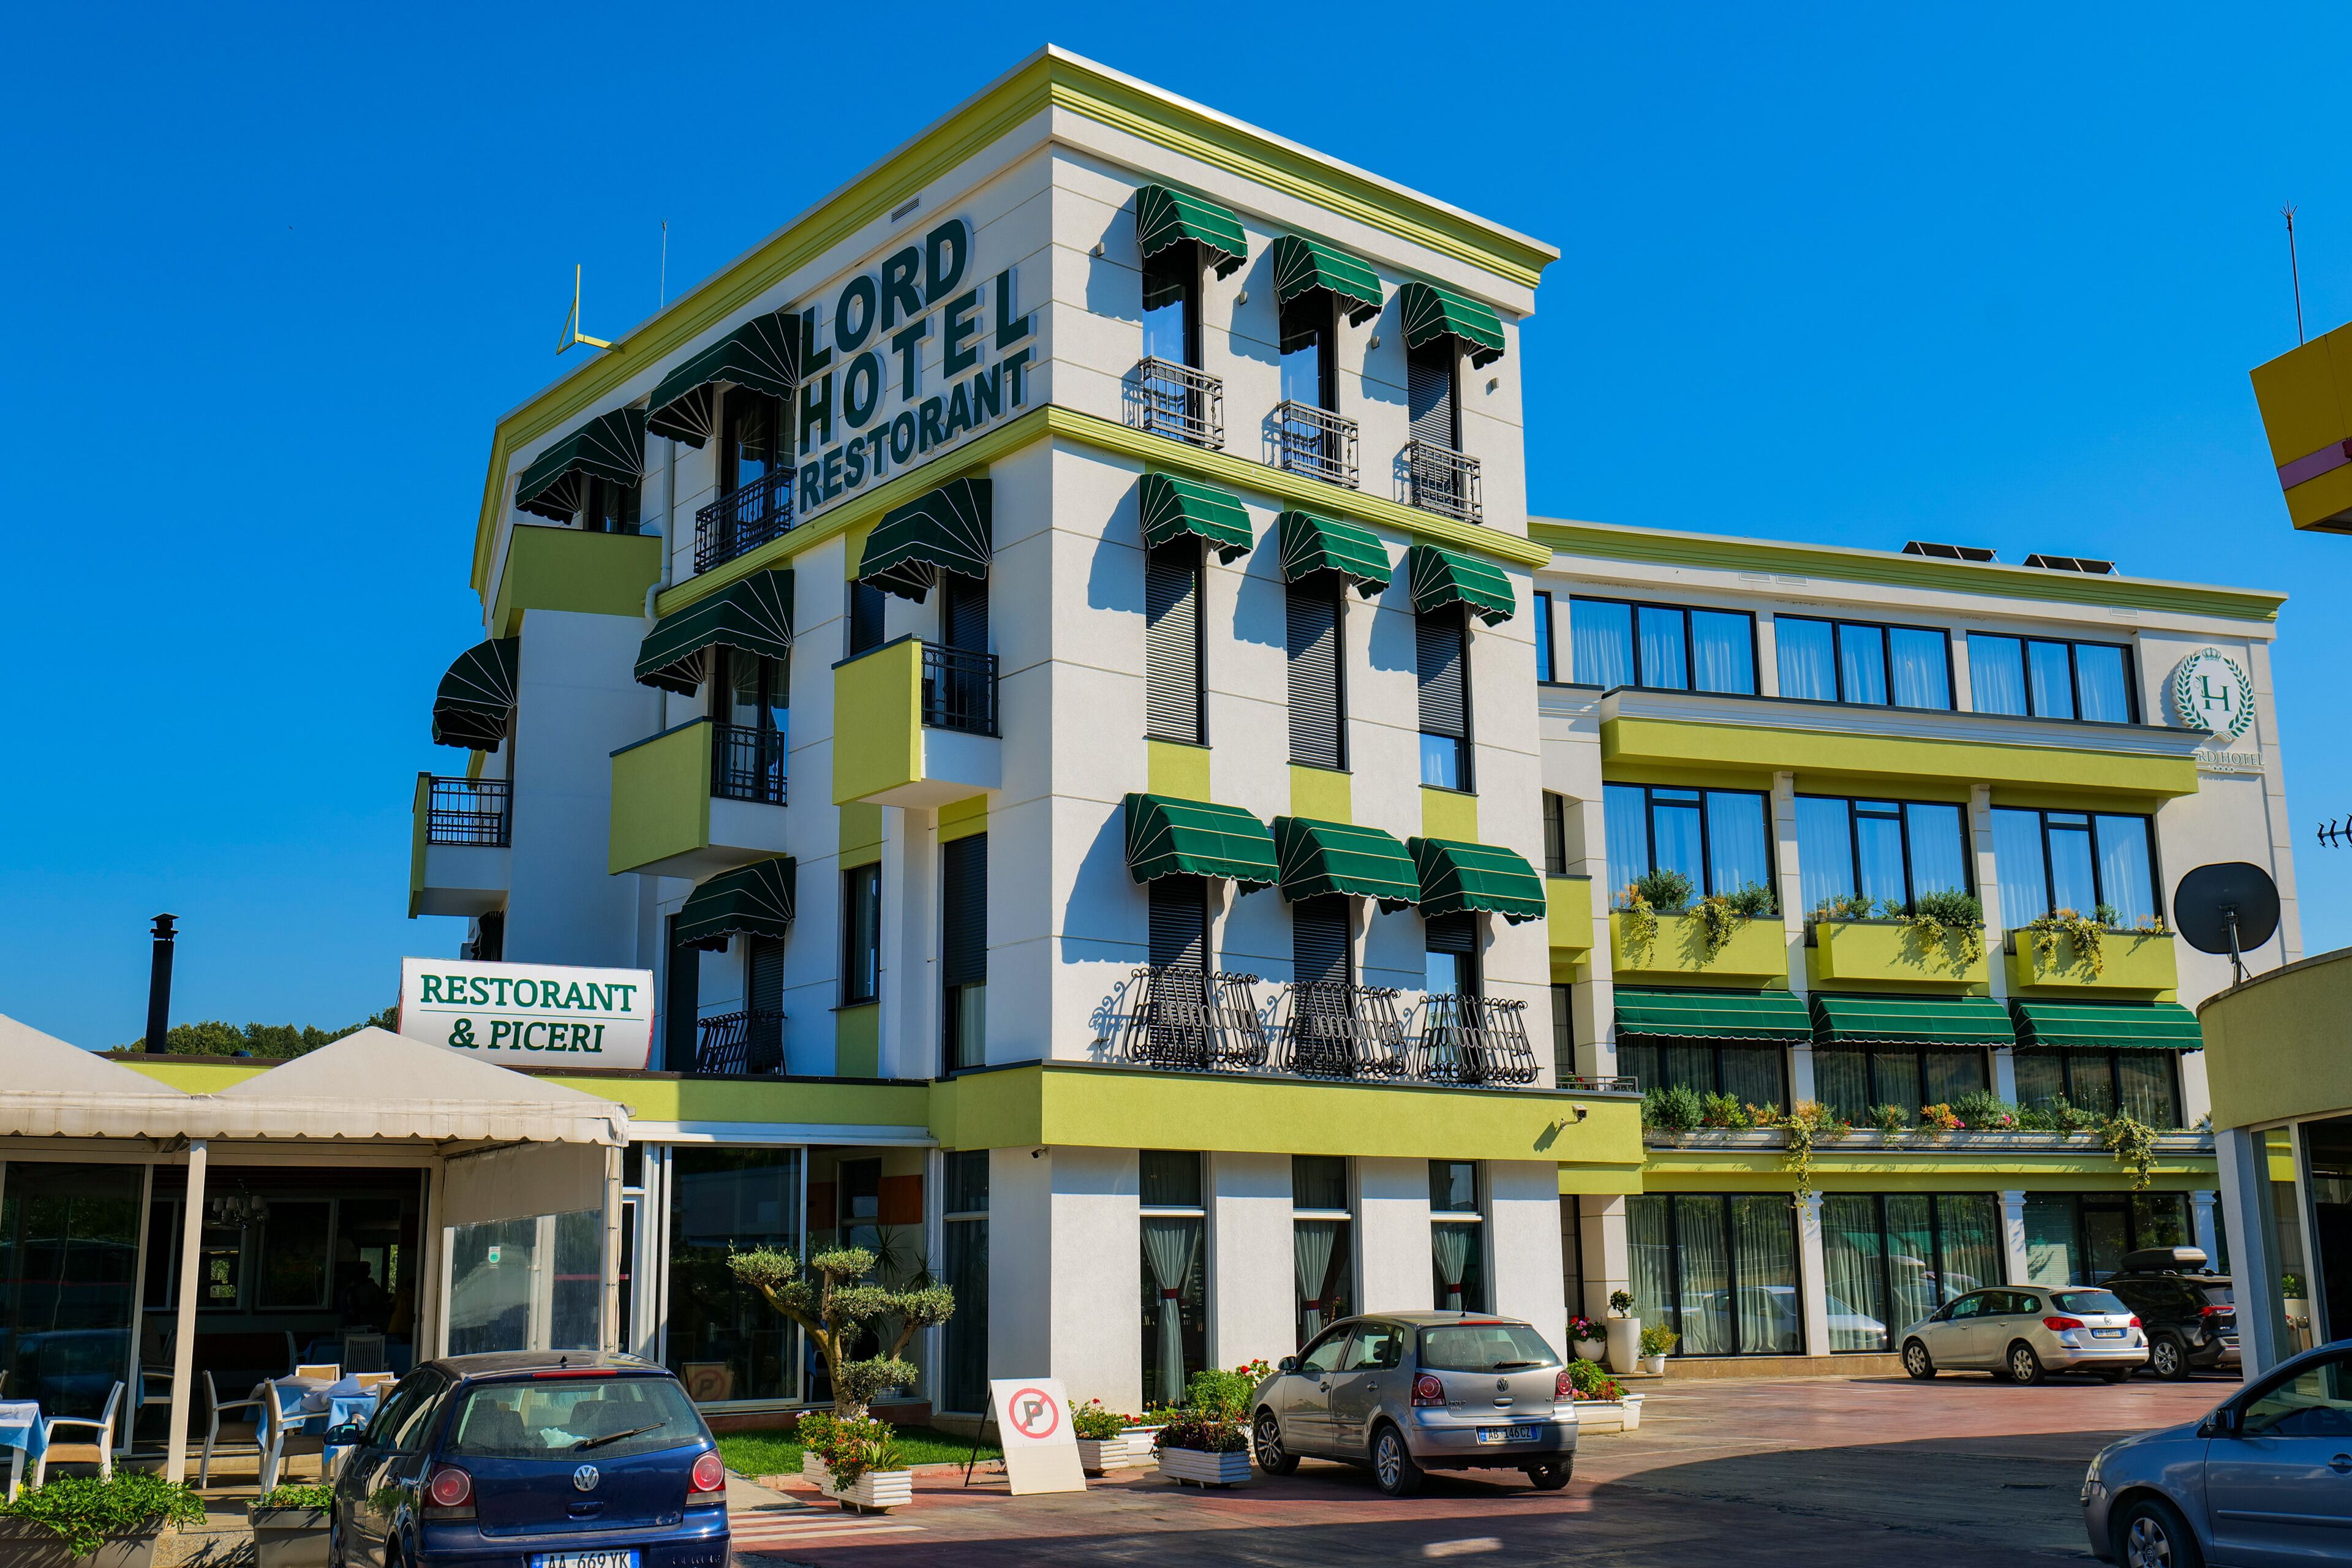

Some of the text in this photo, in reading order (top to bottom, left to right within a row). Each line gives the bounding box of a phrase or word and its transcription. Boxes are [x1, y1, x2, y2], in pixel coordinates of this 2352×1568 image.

[801, 218, 973, 381] LORD
[800, 268, 1033, 458] HOTEL
[799, 347, 1033, 515] RESTORANT
[2198, 750, 2264, 766] RD HOTEL
[420, 974, 638, 1012] RESTORANT
[448, 1017, 606, 1053] & PICERI
[1023, 1400, 1044, 1427] P
[1488, 1428, 1499, 1439] AB
